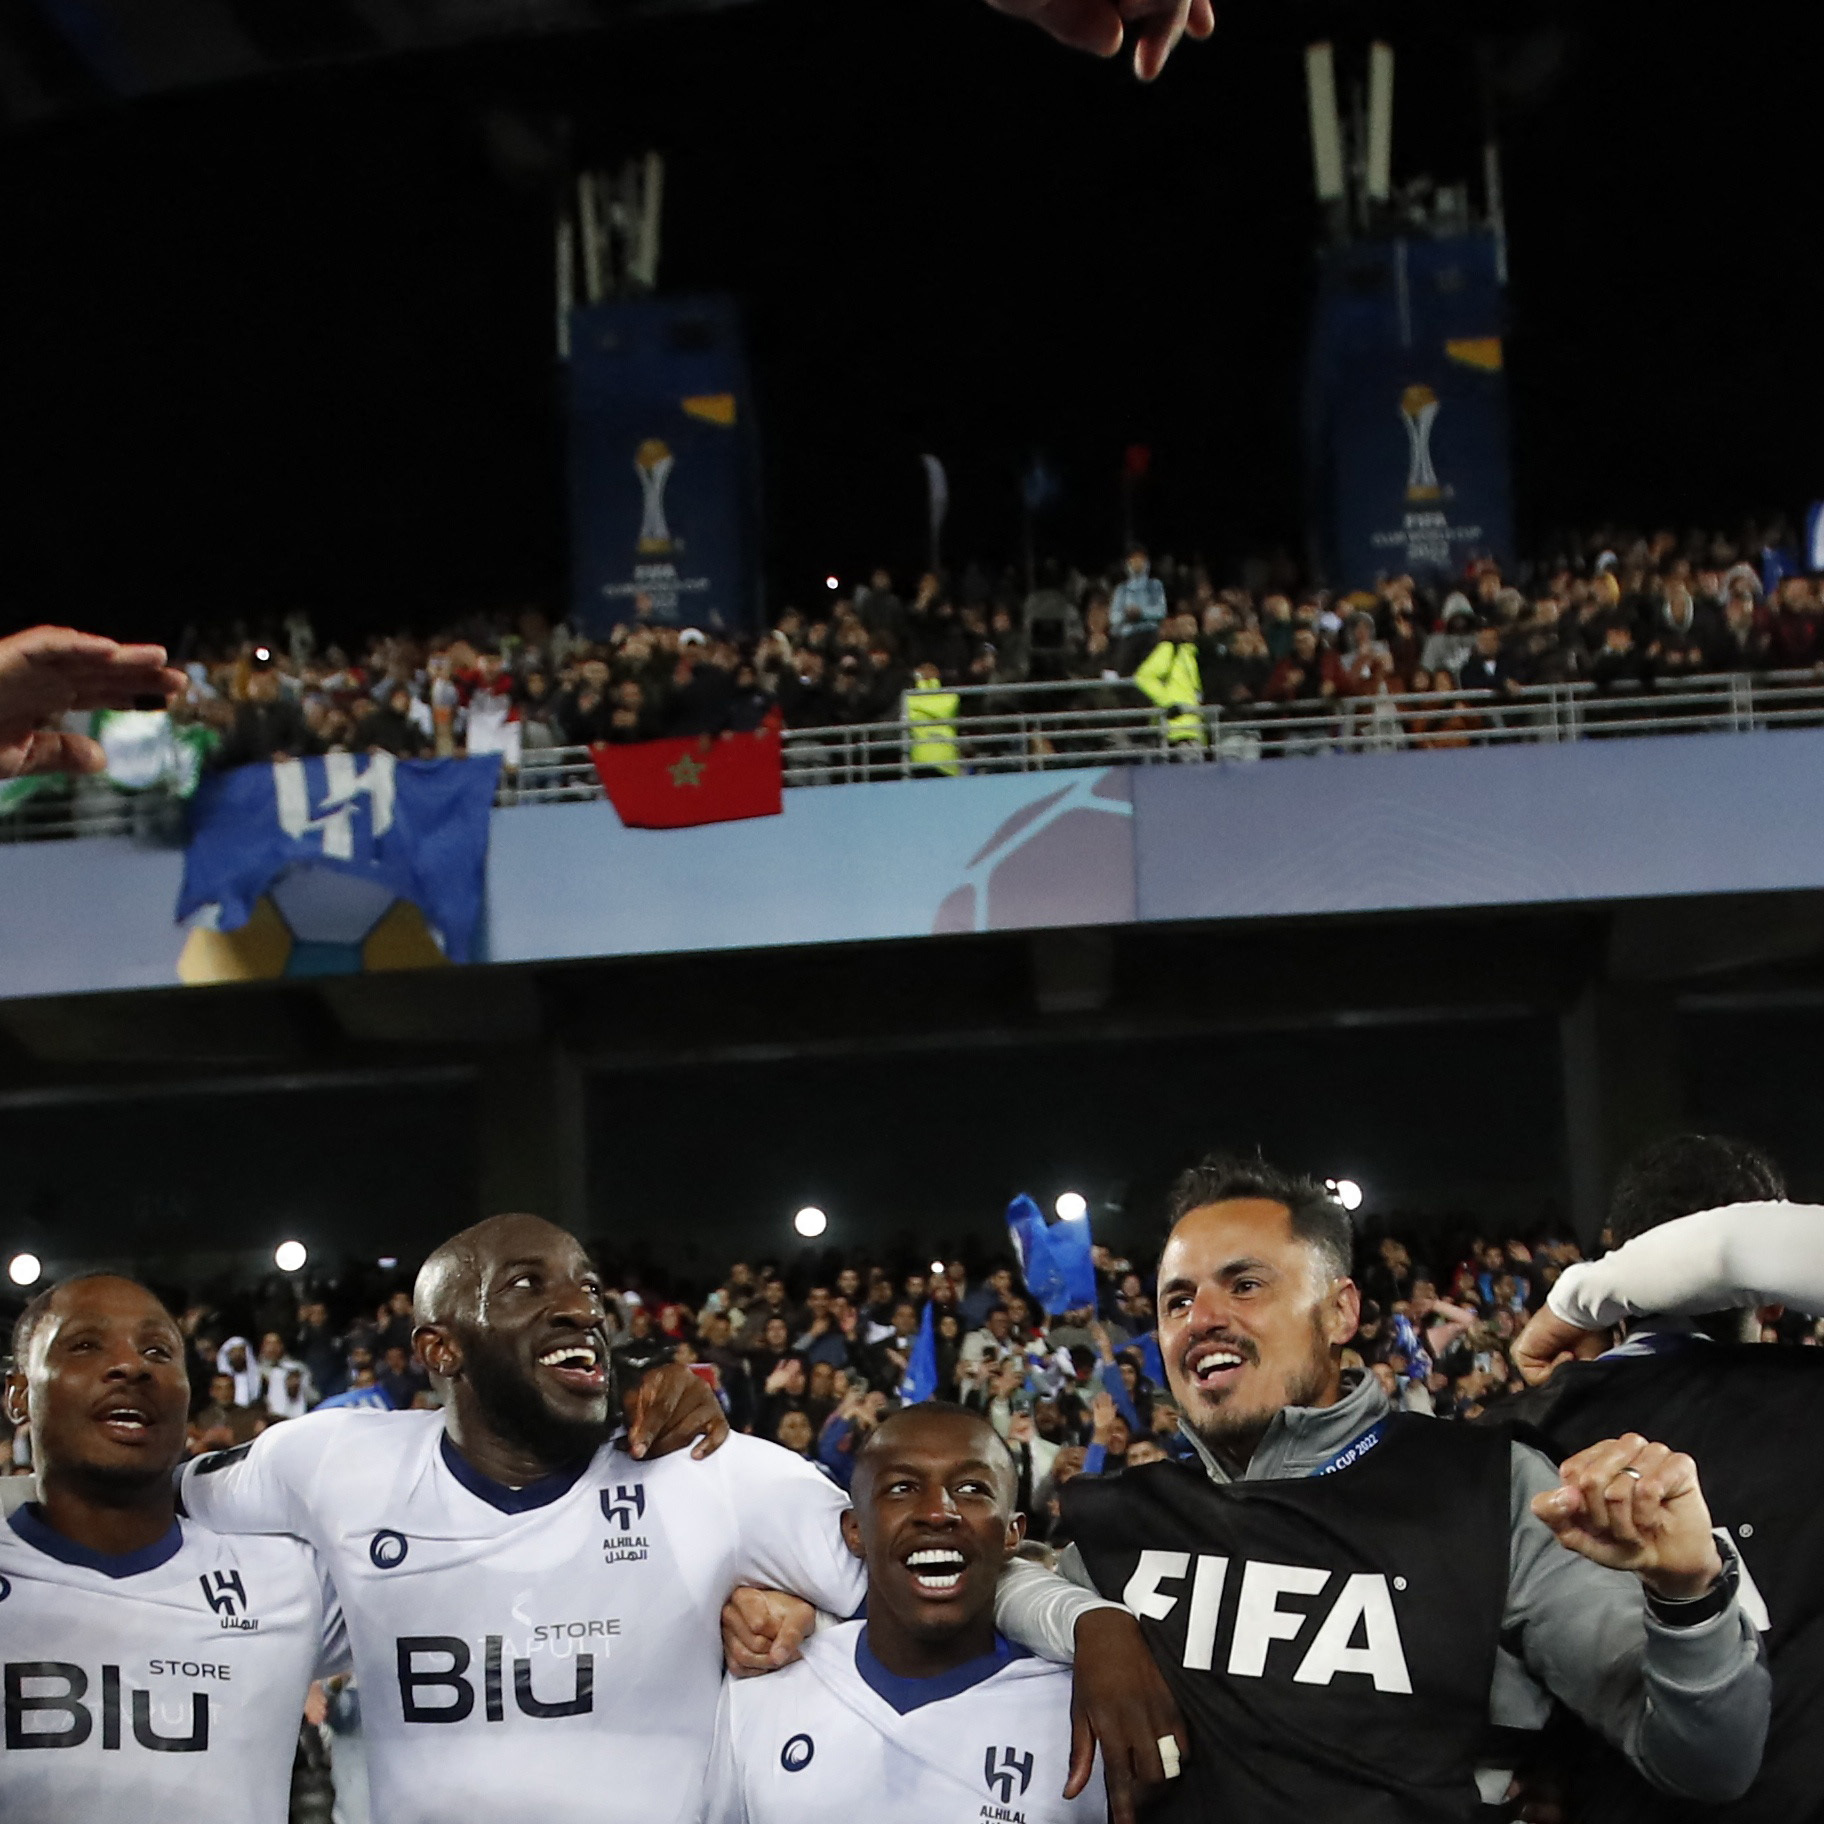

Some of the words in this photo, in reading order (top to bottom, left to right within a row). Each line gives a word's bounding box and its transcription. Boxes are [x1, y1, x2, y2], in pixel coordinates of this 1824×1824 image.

[1336, 1448, 1357, 1470] CUP
[1355, 1433, 1379, 1456] 2022
[603, 1536, 649, 1550] ALHILAL
[534, 1618, 622, 1642] STORE
[1122, 1549, 1414, 1695] FIFA
[149, 1659, 232, 1681] STORE
